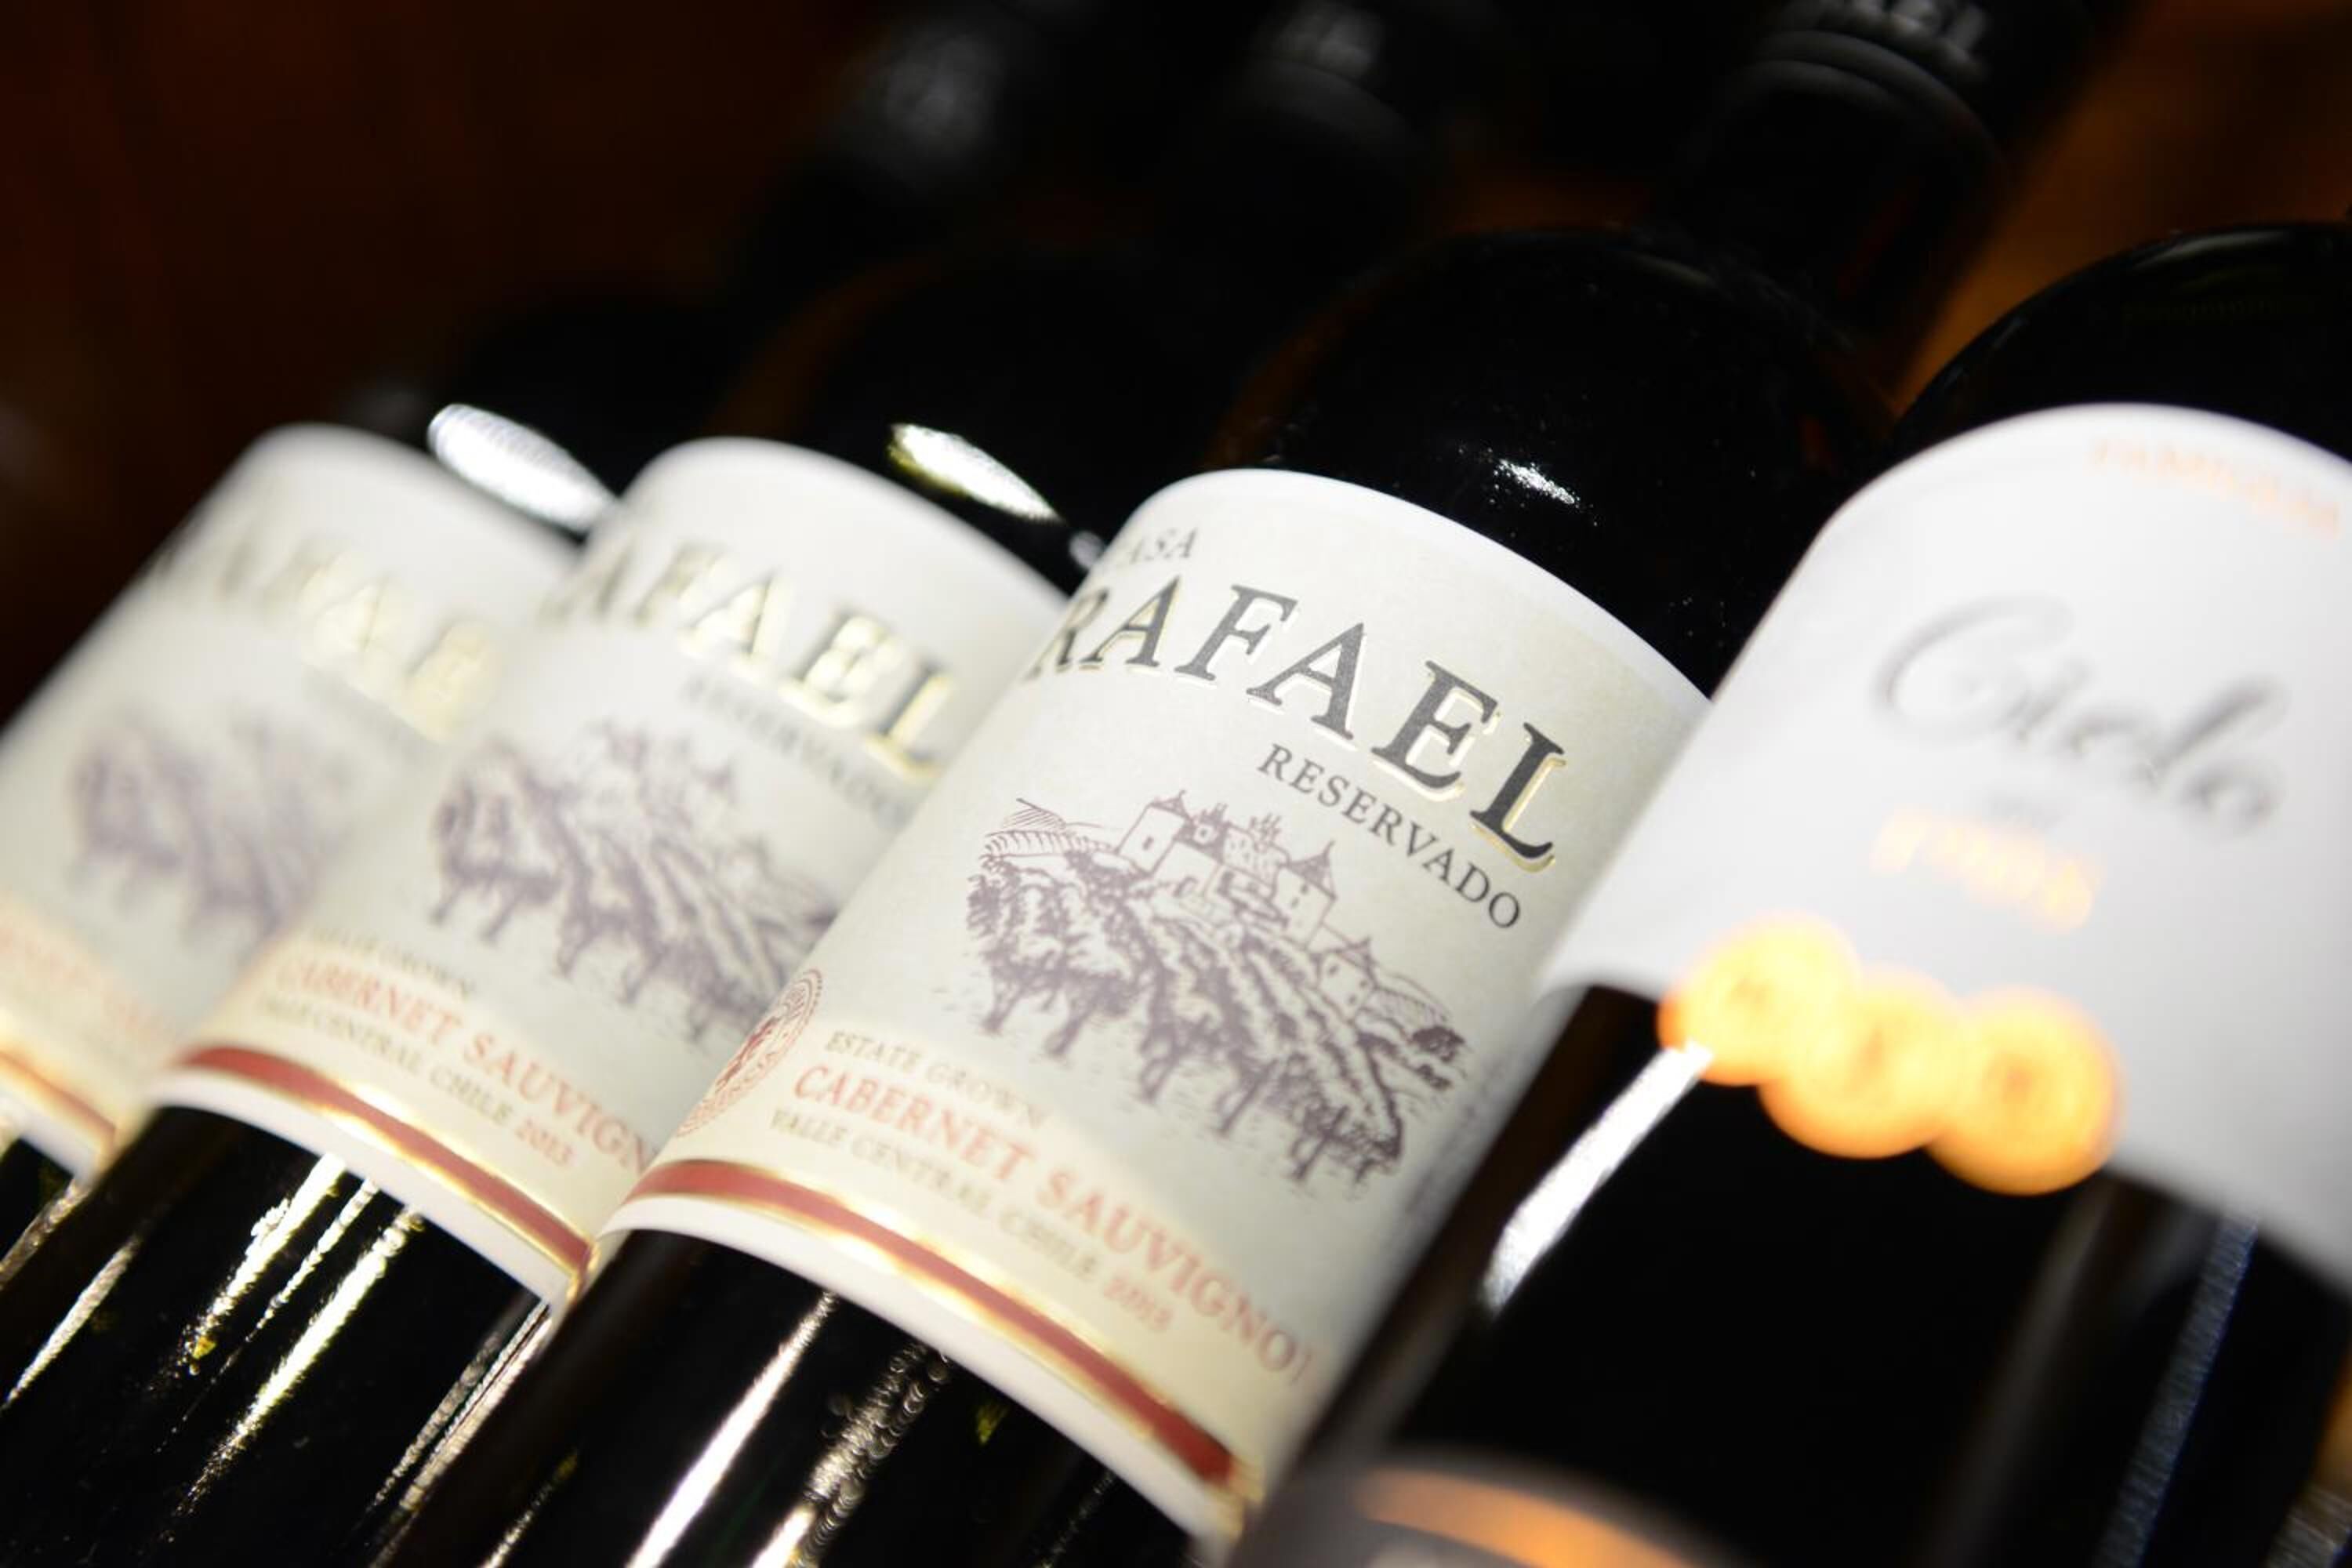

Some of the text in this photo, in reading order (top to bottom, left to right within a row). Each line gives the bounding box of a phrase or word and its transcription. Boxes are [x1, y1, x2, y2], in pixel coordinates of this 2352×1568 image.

[1105, 527, 1200, 566] ASA
[1020, 575, 1566, 870] RAFAEL
[1257, 743, 1522, 929] RESERVADO
[824, 1029, 924, 1078] ESTATE
[793, 1064, 1040, 1183] CABERNET
